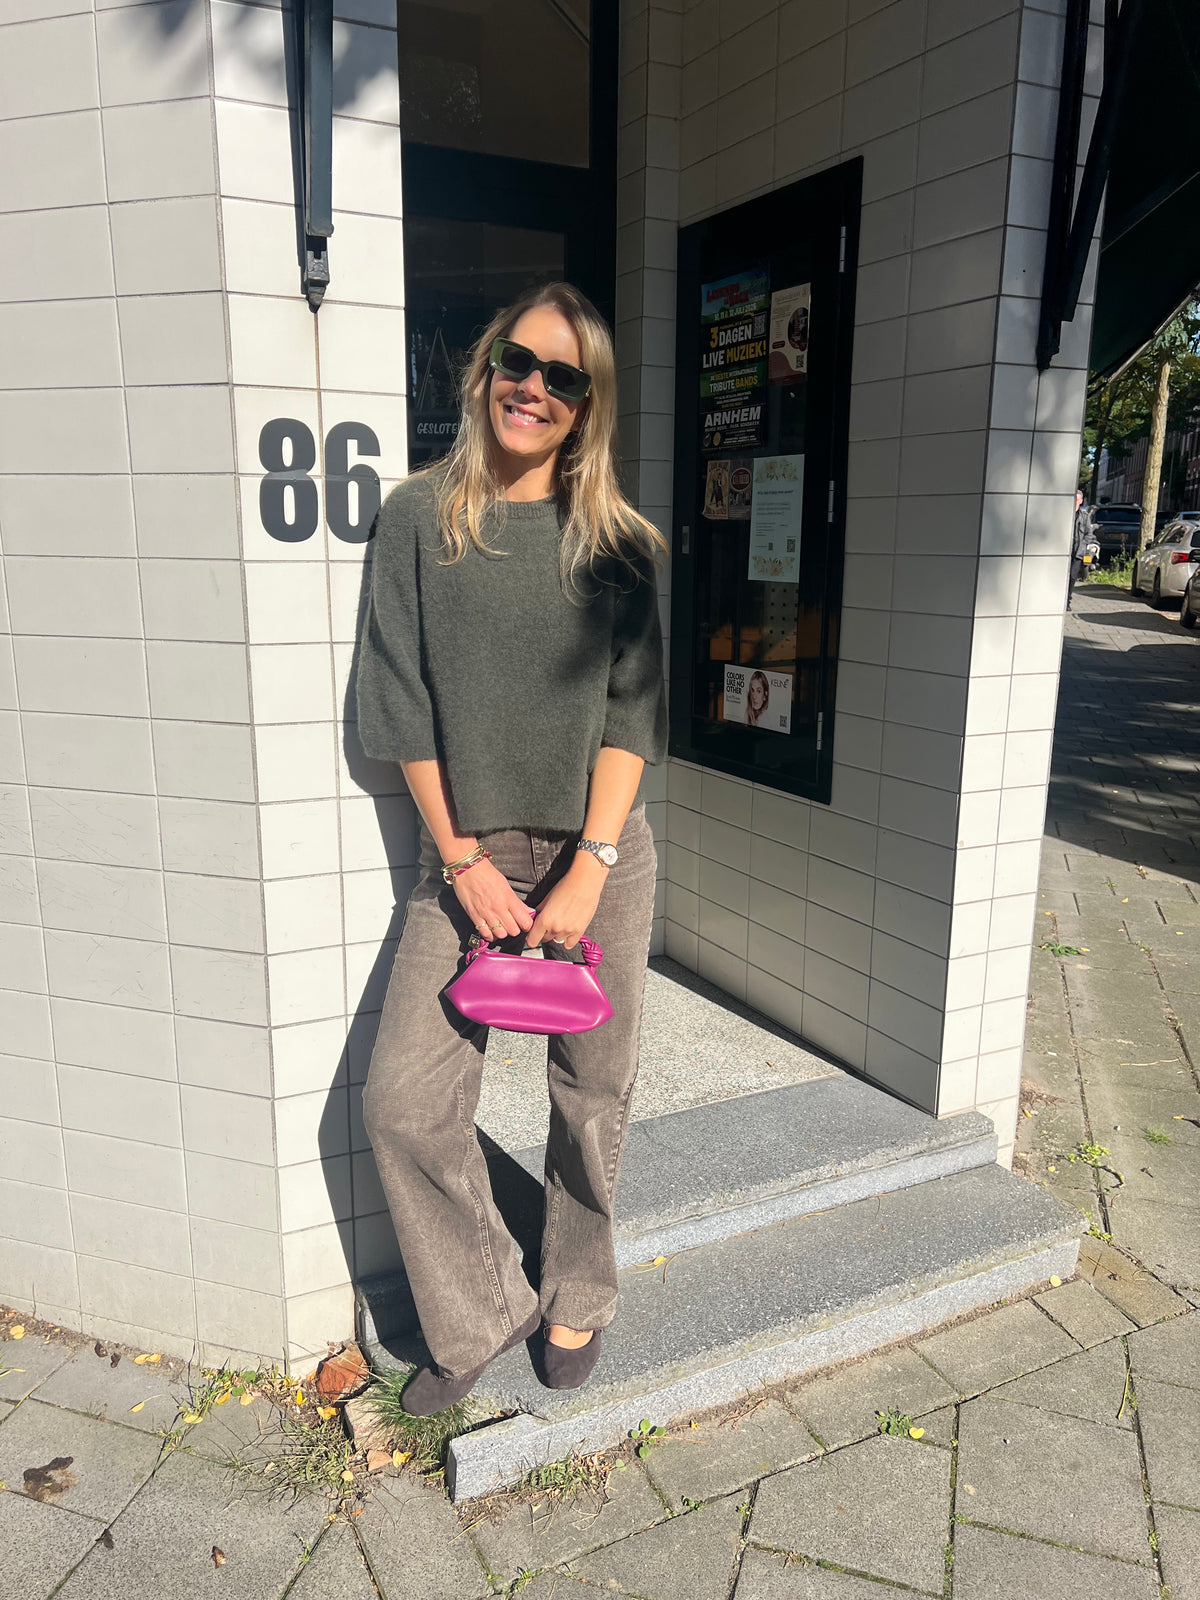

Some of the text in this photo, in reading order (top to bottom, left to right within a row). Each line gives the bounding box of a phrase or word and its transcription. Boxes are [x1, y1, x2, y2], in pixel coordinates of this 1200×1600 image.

[710, 326, 719, 348] 3
[719, 324, 753, 346] DAGEN
[703, 340, 767, 368] LIVE MUZIEK!
[709, 375, 759, 393] TRIBUTE BANDS
[704, 406, 762, 428] ARNHEM
[259, 418, 381, 543] 86
[726, 679, 745, 688] LIKE NO
[727, 671, 745, 681] COLORS
[771, 679, 788, 689] KEUNE
[726, 686, 742, 695] OTHER
